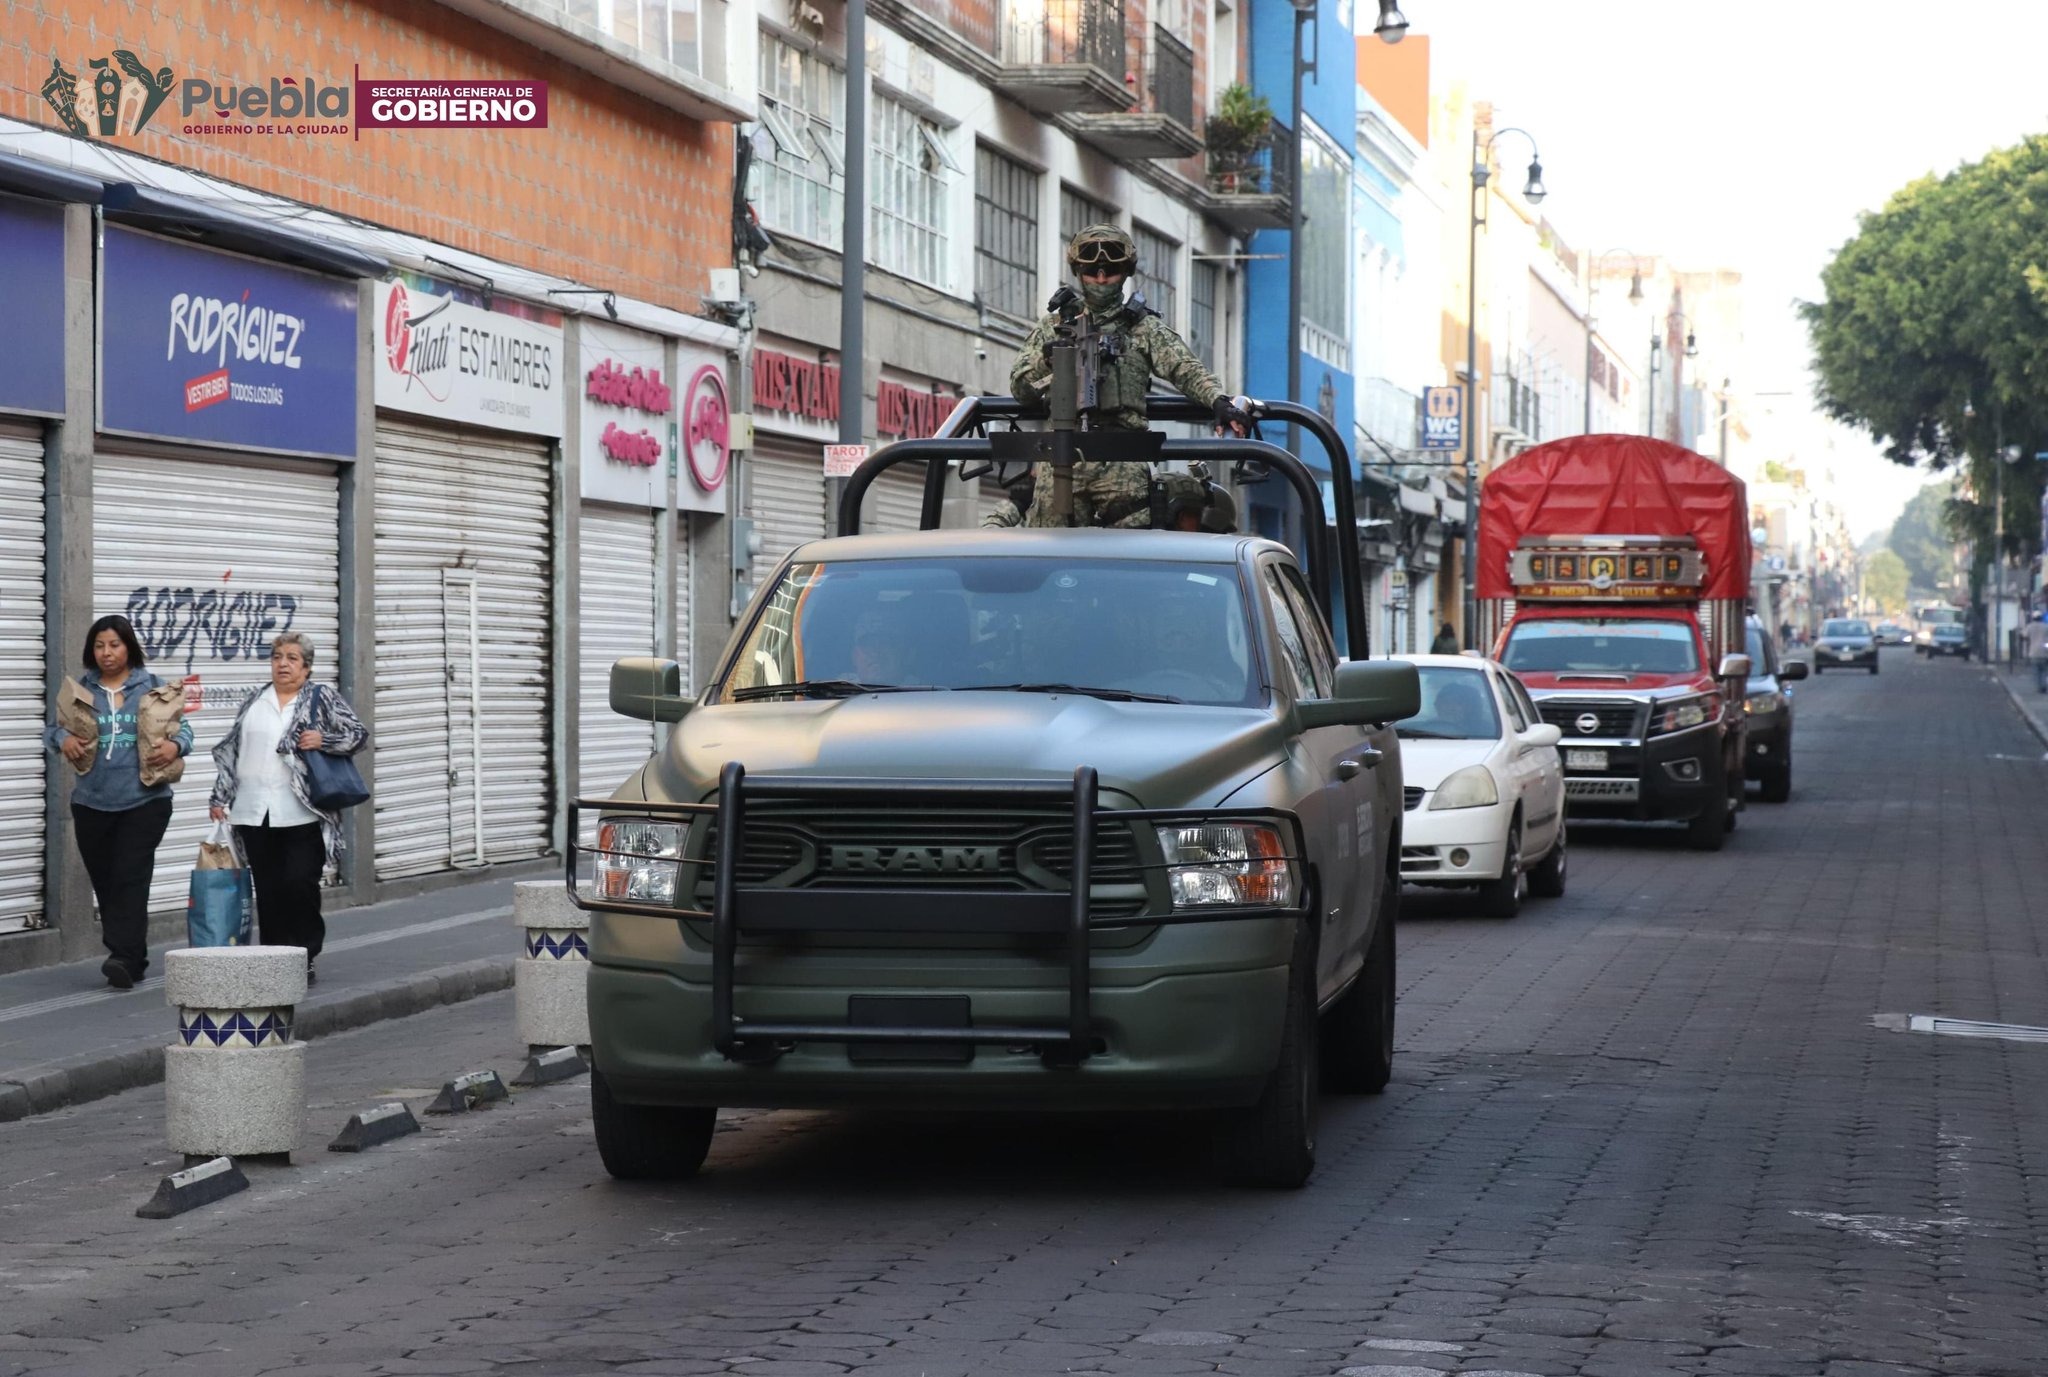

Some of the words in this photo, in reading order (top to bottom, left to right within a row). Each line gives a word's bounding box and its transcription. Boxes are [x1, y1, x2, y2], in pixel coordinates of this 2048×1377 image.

[167, 288, 301, 369] RODRÍGUEZ
[459, 325, 552, 391] ESTAMBRES
[753, 348, 787, 411] MIS
[230, 382, 254, 402] TODOS
[253, 386, 267, 404] LOS
[1425, 416, 1459, 434] WC
[826, 446, 866, 456] TAROT
[831, 845, 1002, 871] RAM
